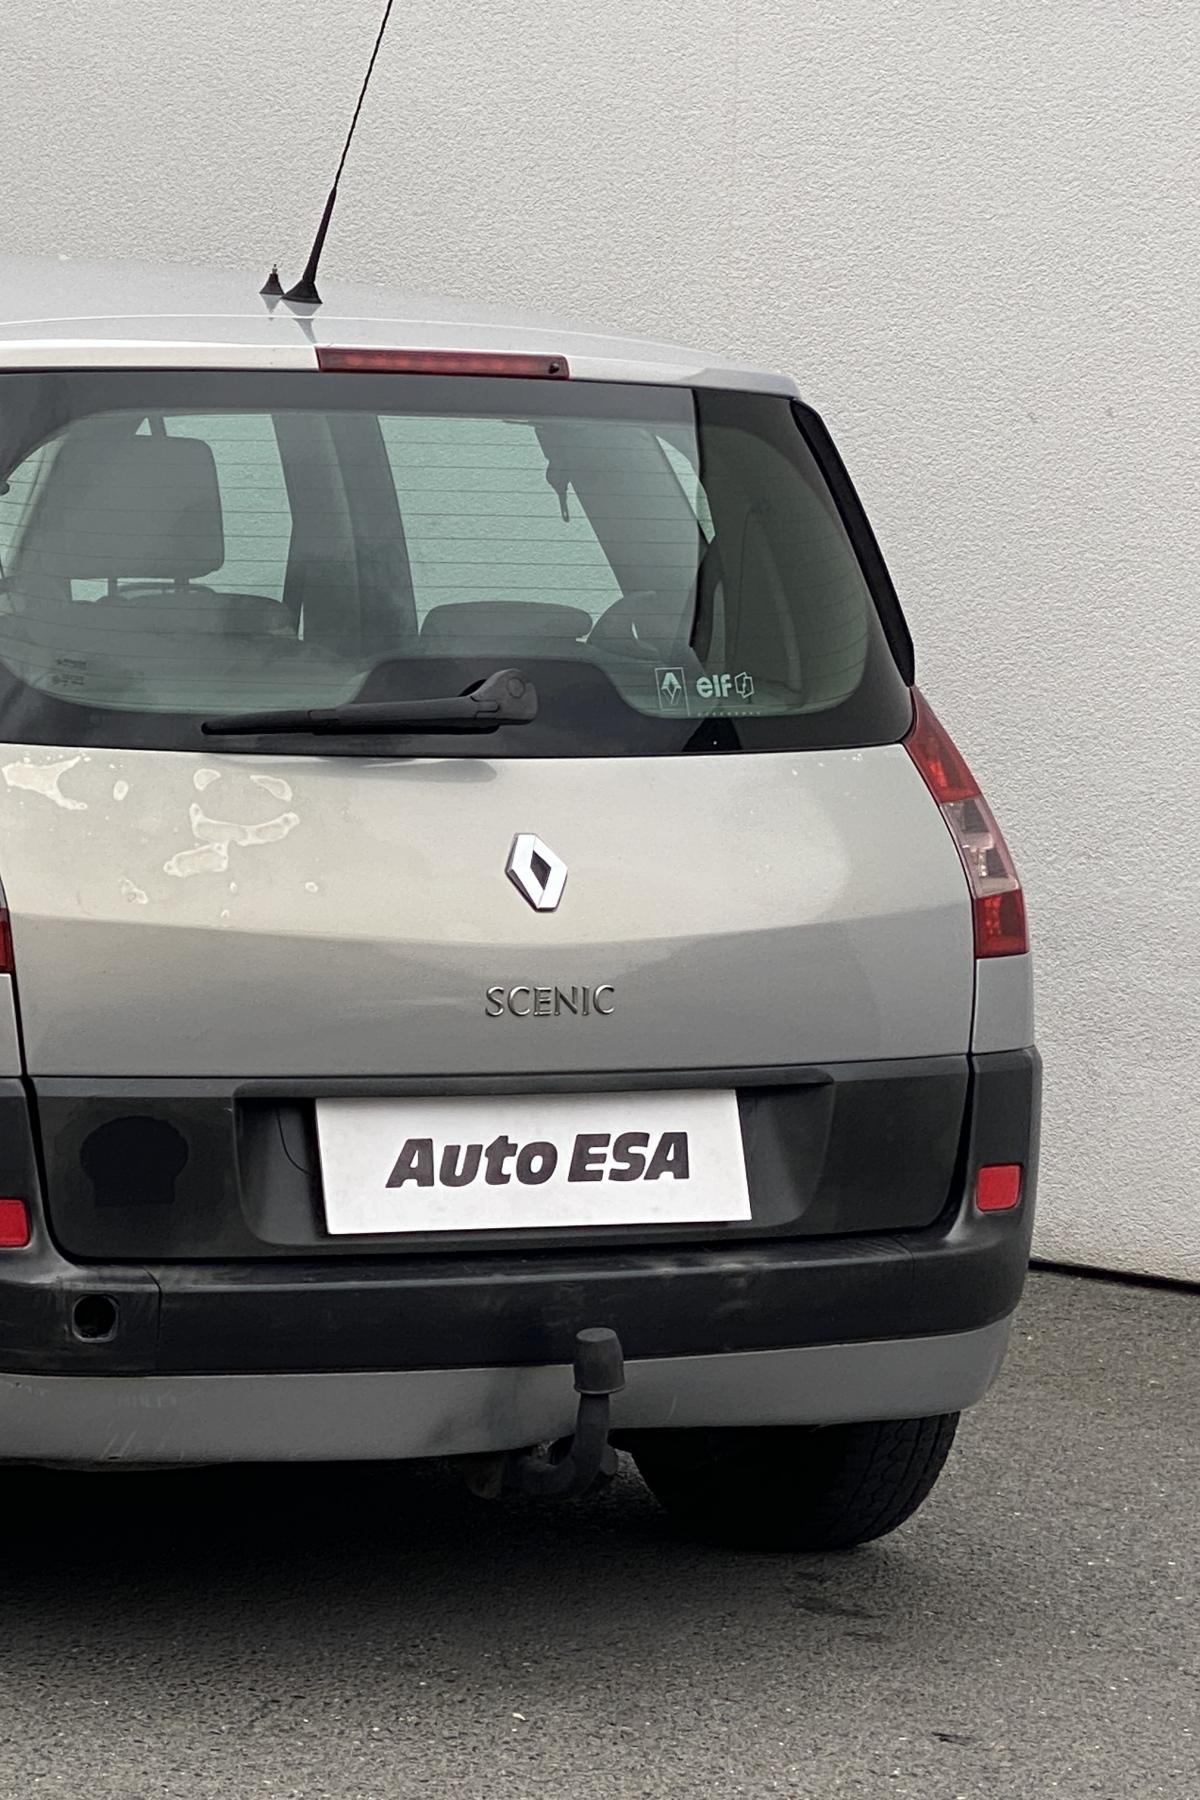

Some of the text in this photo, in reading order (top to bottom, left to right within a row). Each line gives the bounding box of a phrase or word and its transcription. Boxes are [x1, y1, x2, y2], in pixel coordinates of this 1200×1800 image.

[696, 673, 732, 698] elf
[485, 984, 615, 1017] SCENIC
[385, 1131, 690, 1188] Auto ESA
